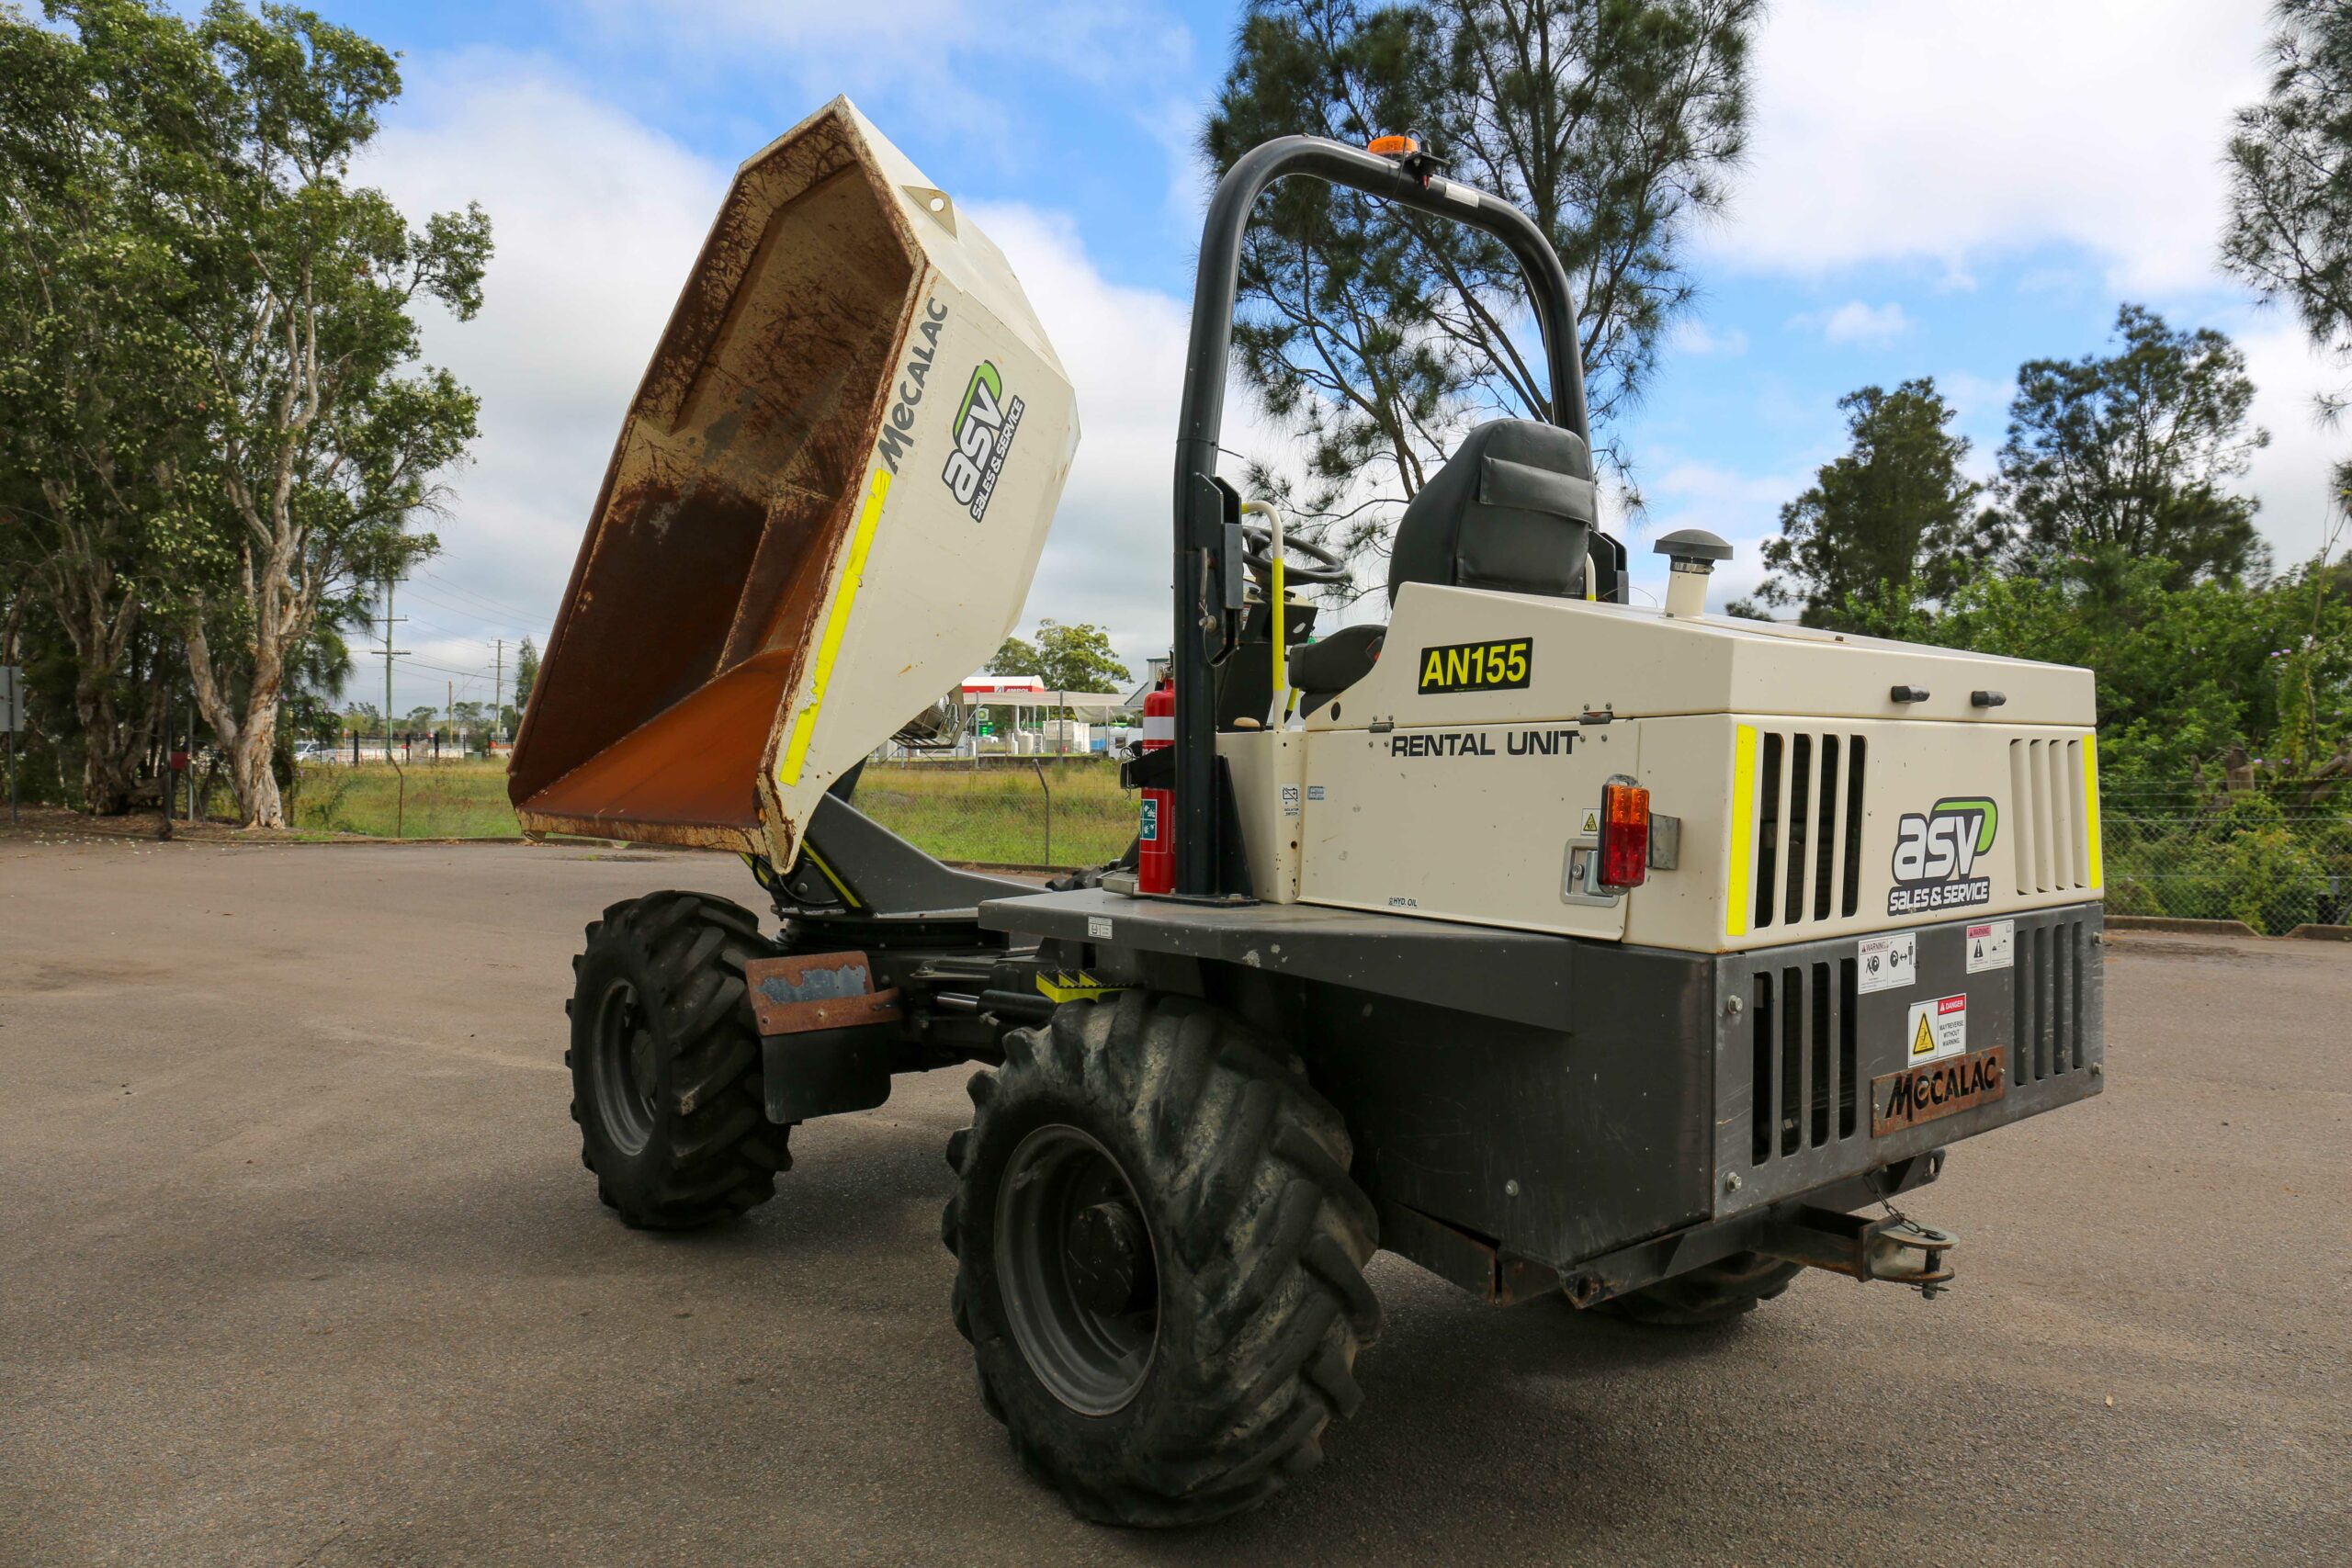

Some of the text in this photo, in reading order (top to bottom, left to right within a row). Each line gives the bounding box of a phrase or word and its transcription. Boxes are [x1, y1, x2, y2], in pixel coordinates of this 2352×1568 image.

[990, 456, 1002, 474] &
[996, 399, 1023, 458] SERVICE
[1421, 643, 1527, 687] AN155
[1391, 730, 1579, 757] RENTAL UNIT
[1408, 898, 1418, 907] OIL
[1929, 886, 1942, 907] &
[1943, 881, 1989, 905] SERVICE
[1946, 999, 1963, 1010] DANGER
[1943, 1029, 1960, 1038] WITHOUT
